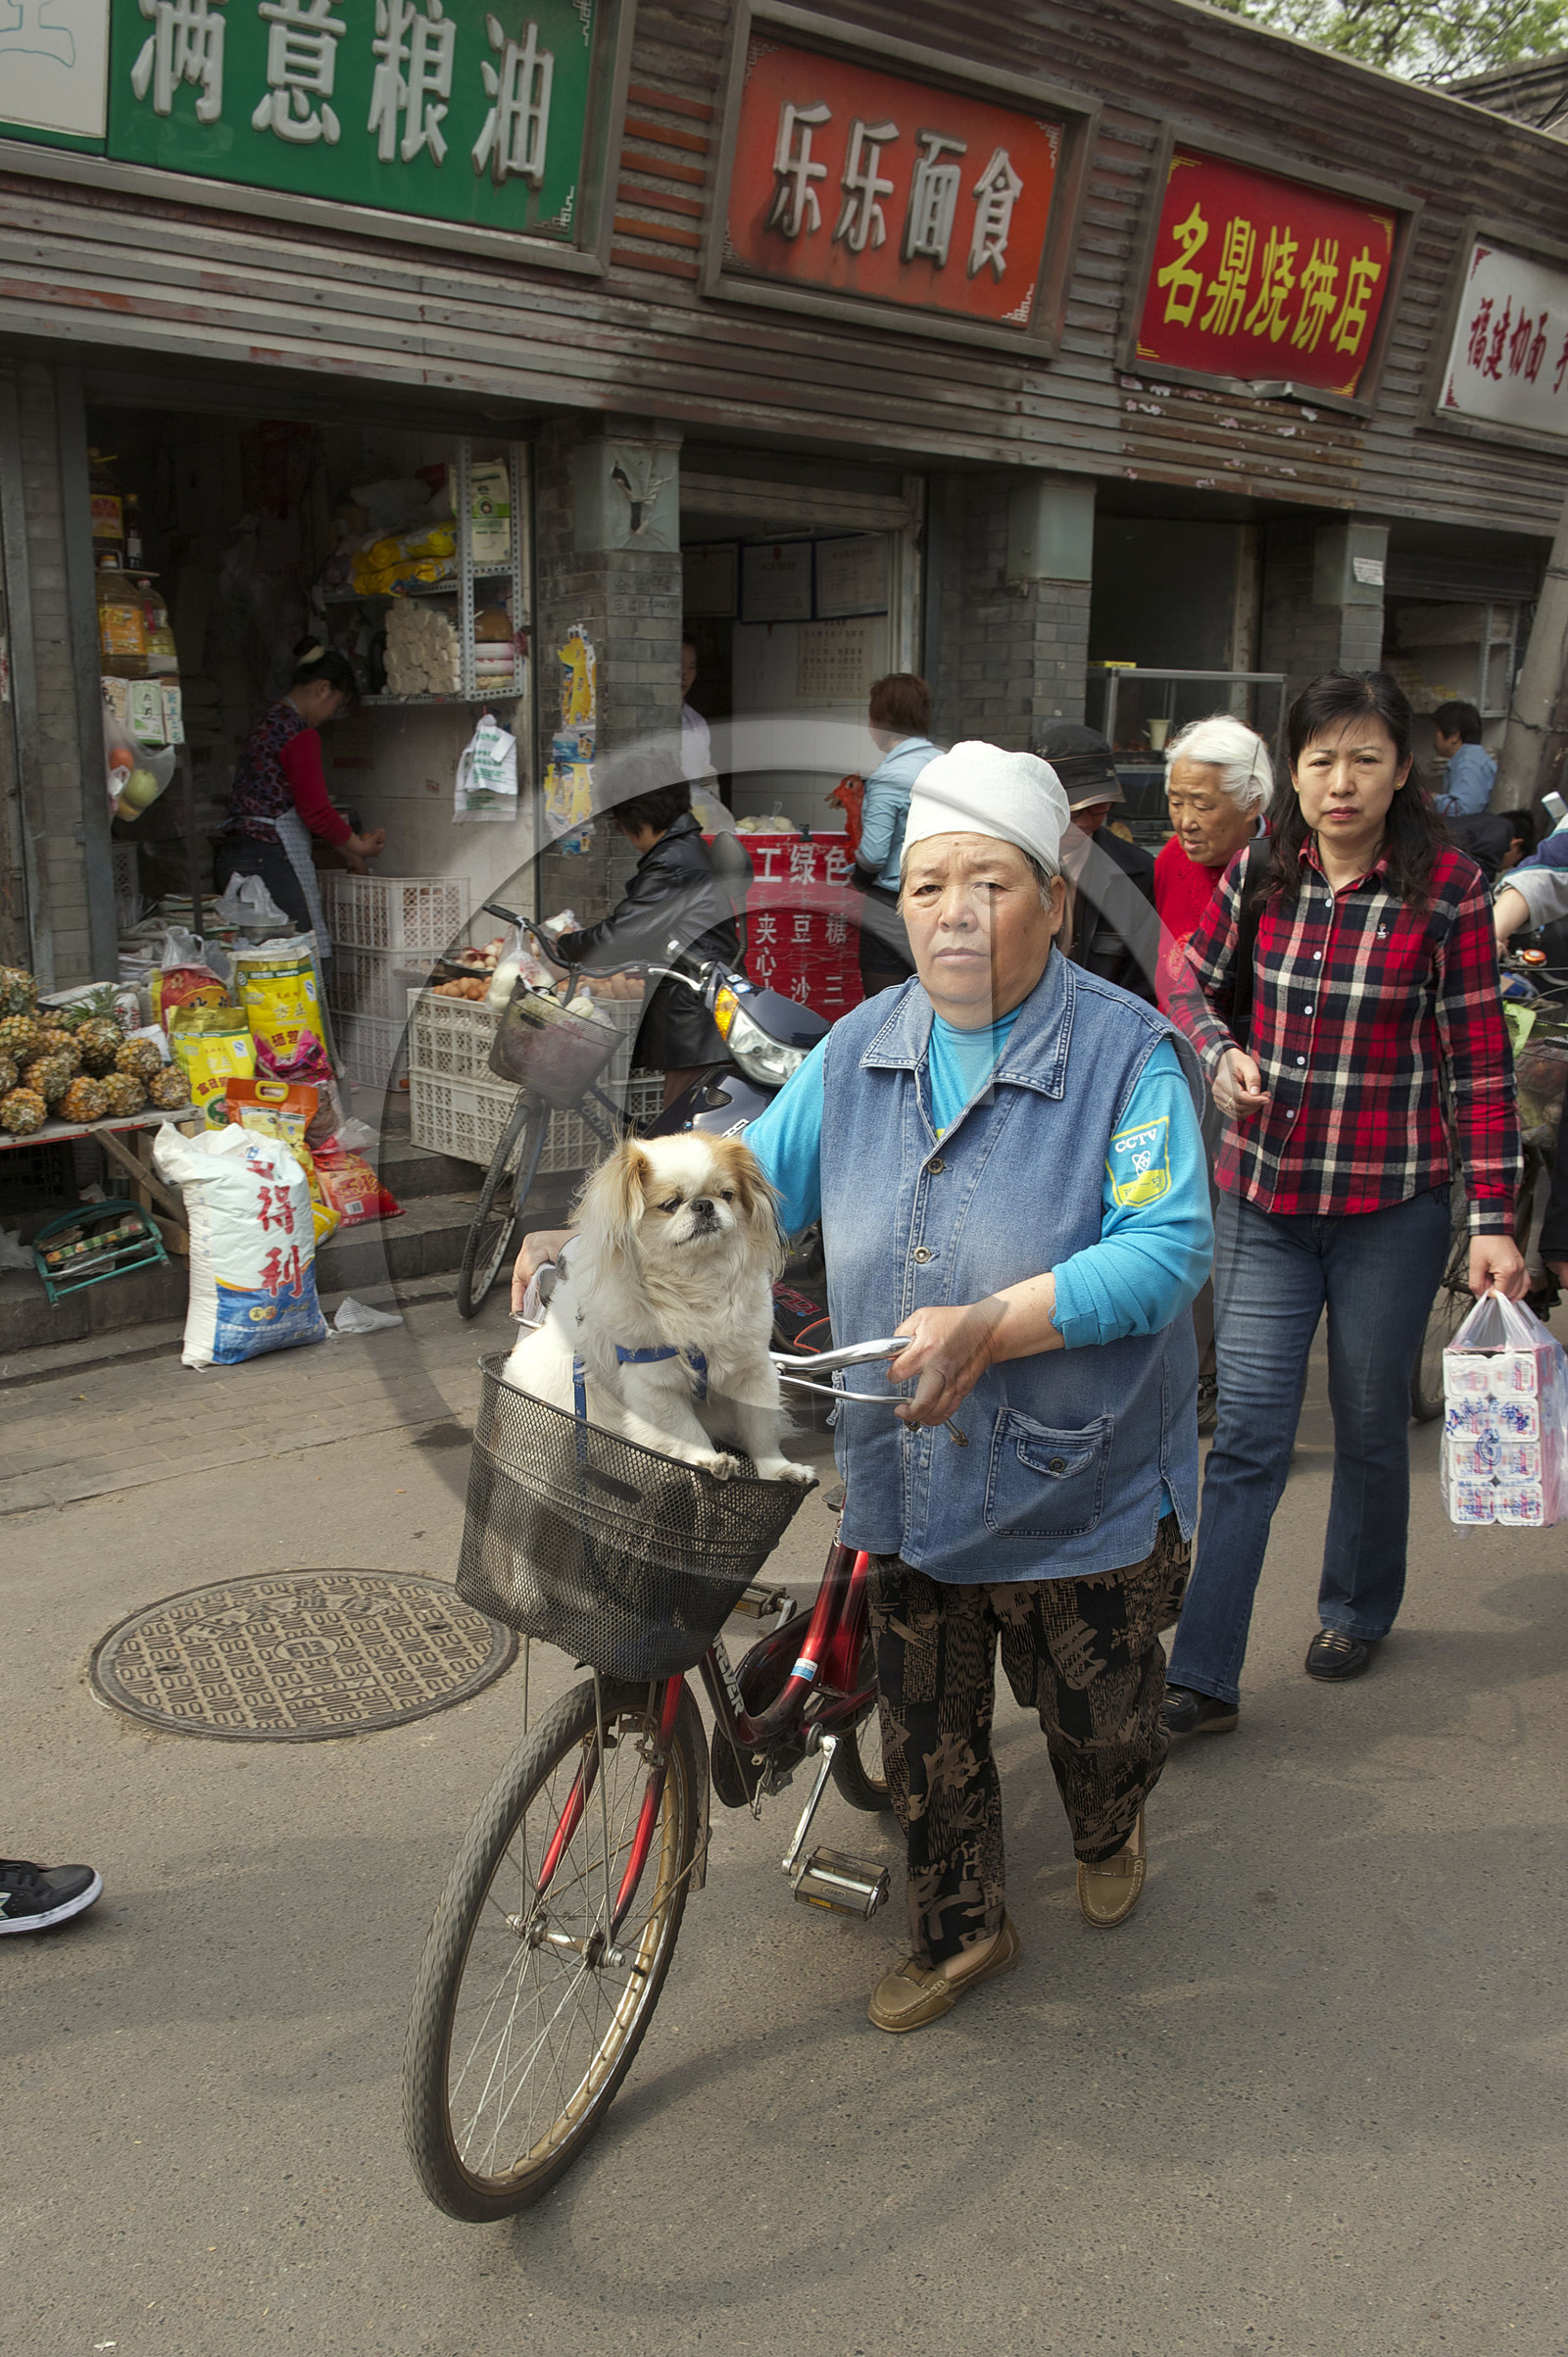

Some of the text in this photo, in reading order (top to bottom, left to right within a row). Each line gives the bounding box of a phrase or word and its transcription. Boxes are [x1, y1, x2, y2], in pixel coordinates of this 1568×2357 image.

[130, 0, 555, 189] 满意粮油
[766, 100, 1024, 282] 乐乐面食
[1156, 202, 1383, 357] 名鼎烧饼店
[754, 844, 851, 886] 工绿色
[791, 914, 811, 1006] 豆沙
[823, 913, 849, 1004] 糖三
[1114, 1128, 1157, 1153] CCTV
[196, 1595, 375, 1635] 北京通信
[290, 1679, 367, 1697] 2007
